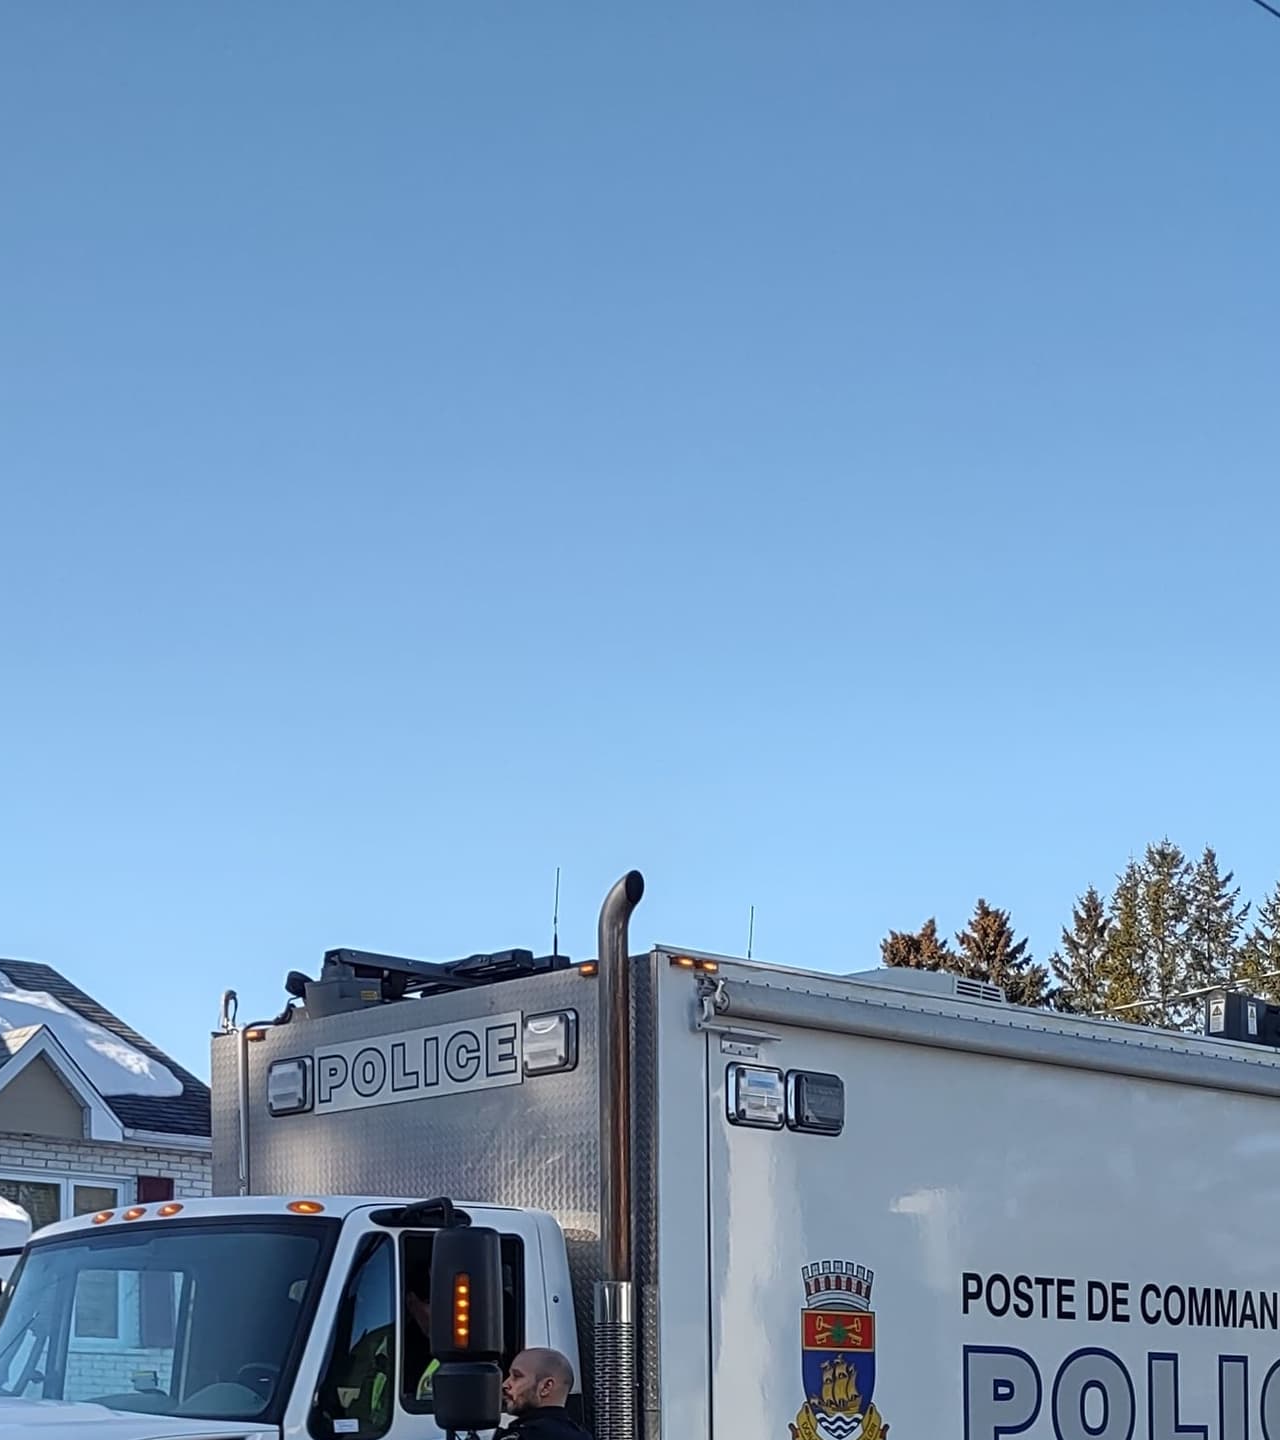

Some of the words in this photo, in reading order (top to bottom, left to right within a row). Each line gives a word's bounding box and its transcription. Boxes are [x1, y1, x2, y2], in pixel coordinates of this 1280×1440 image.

[319, 1023, 517, 1103] POLICE
[962, 1272, 1077, 1320] POSTE
[1088, 1280, 1130, 1322] DE
